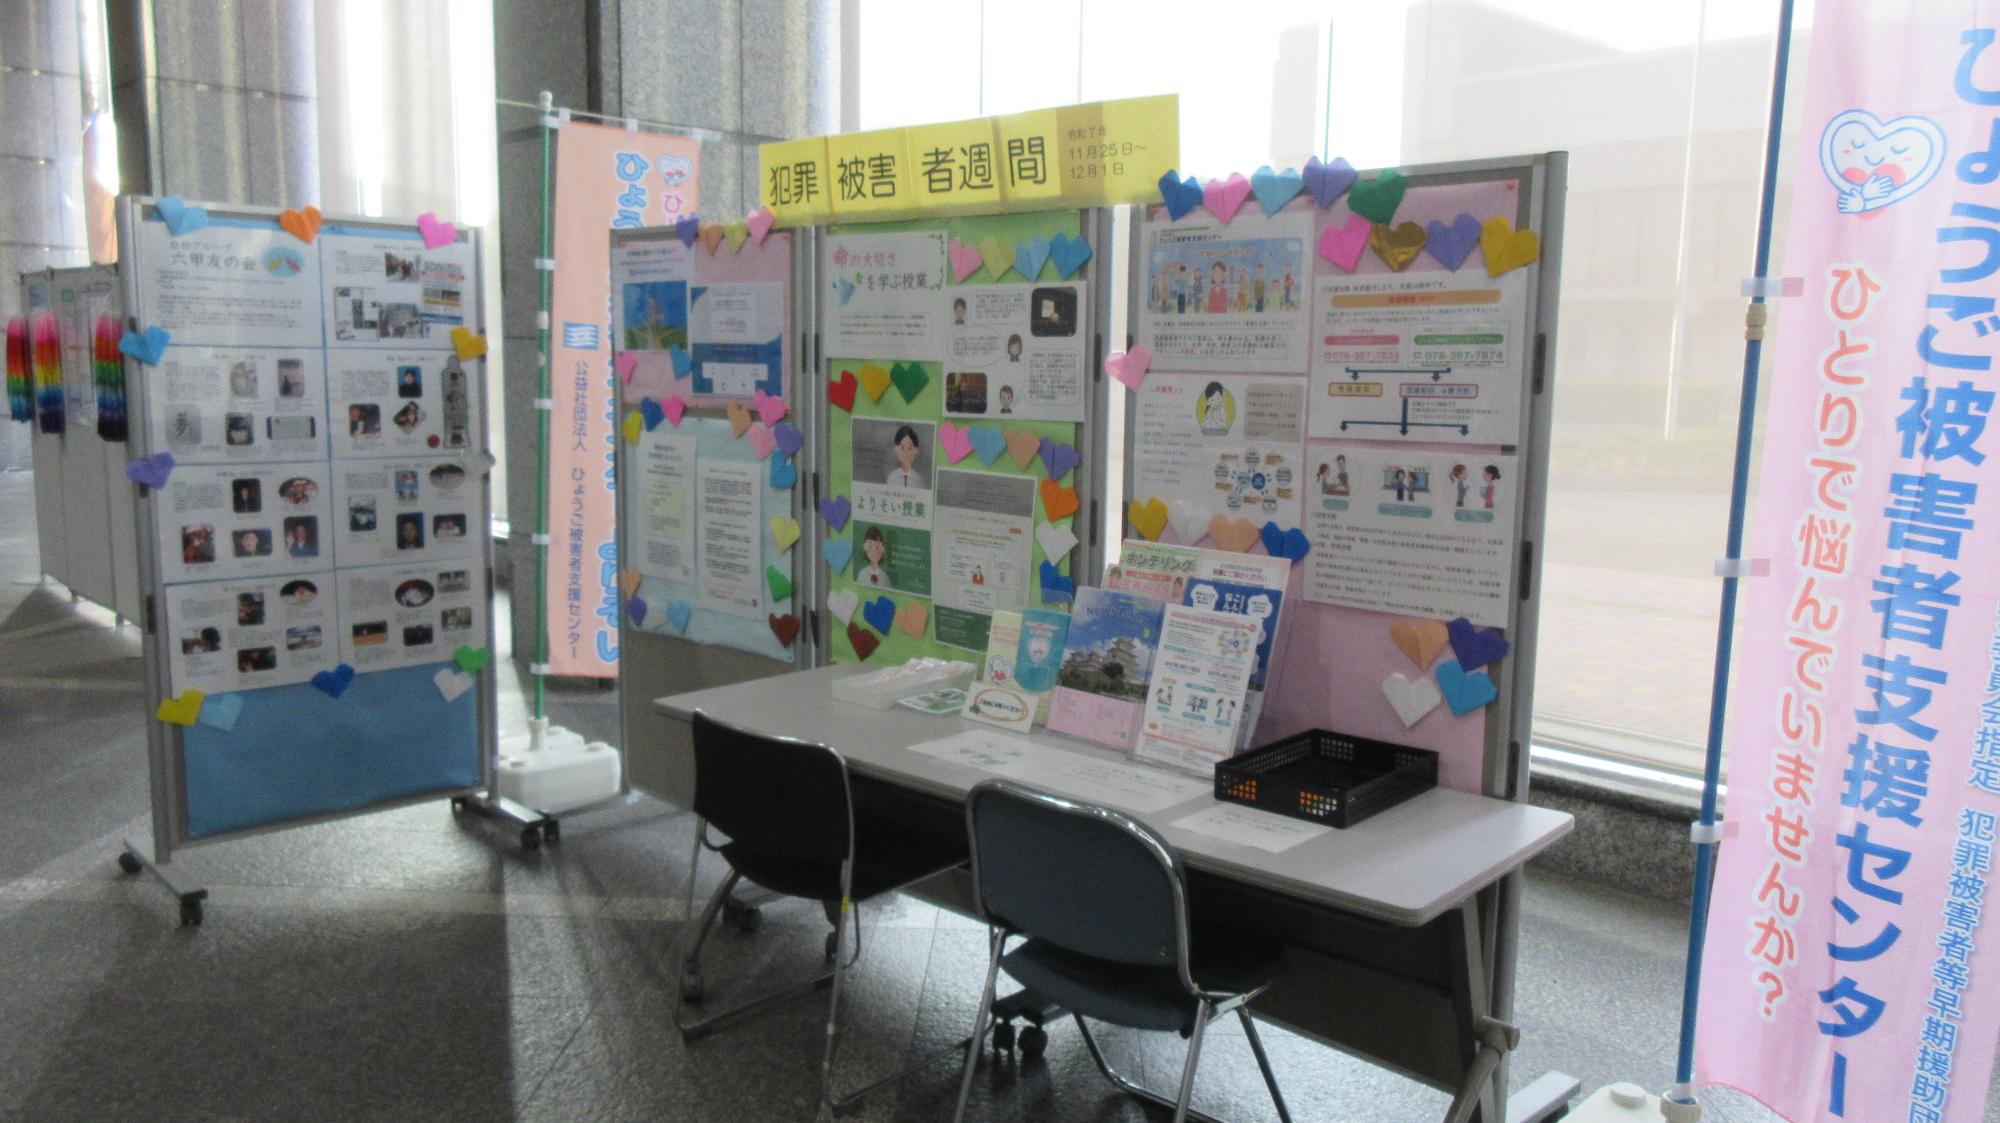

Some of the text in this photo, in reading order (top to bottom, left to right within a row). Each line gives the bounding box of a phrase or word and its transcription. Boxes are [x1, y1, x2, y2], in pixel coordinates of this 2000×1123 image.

[769, 135, 1047, 206] 犯罪被害者週間
[1070, 162, 1124, 180] 12月1日
[867, 271, 928, 292] を学ぶ授業
[857, 495, 927, 519] よりそい授業
[1127, 551, 1196, 572] ホンデリング
